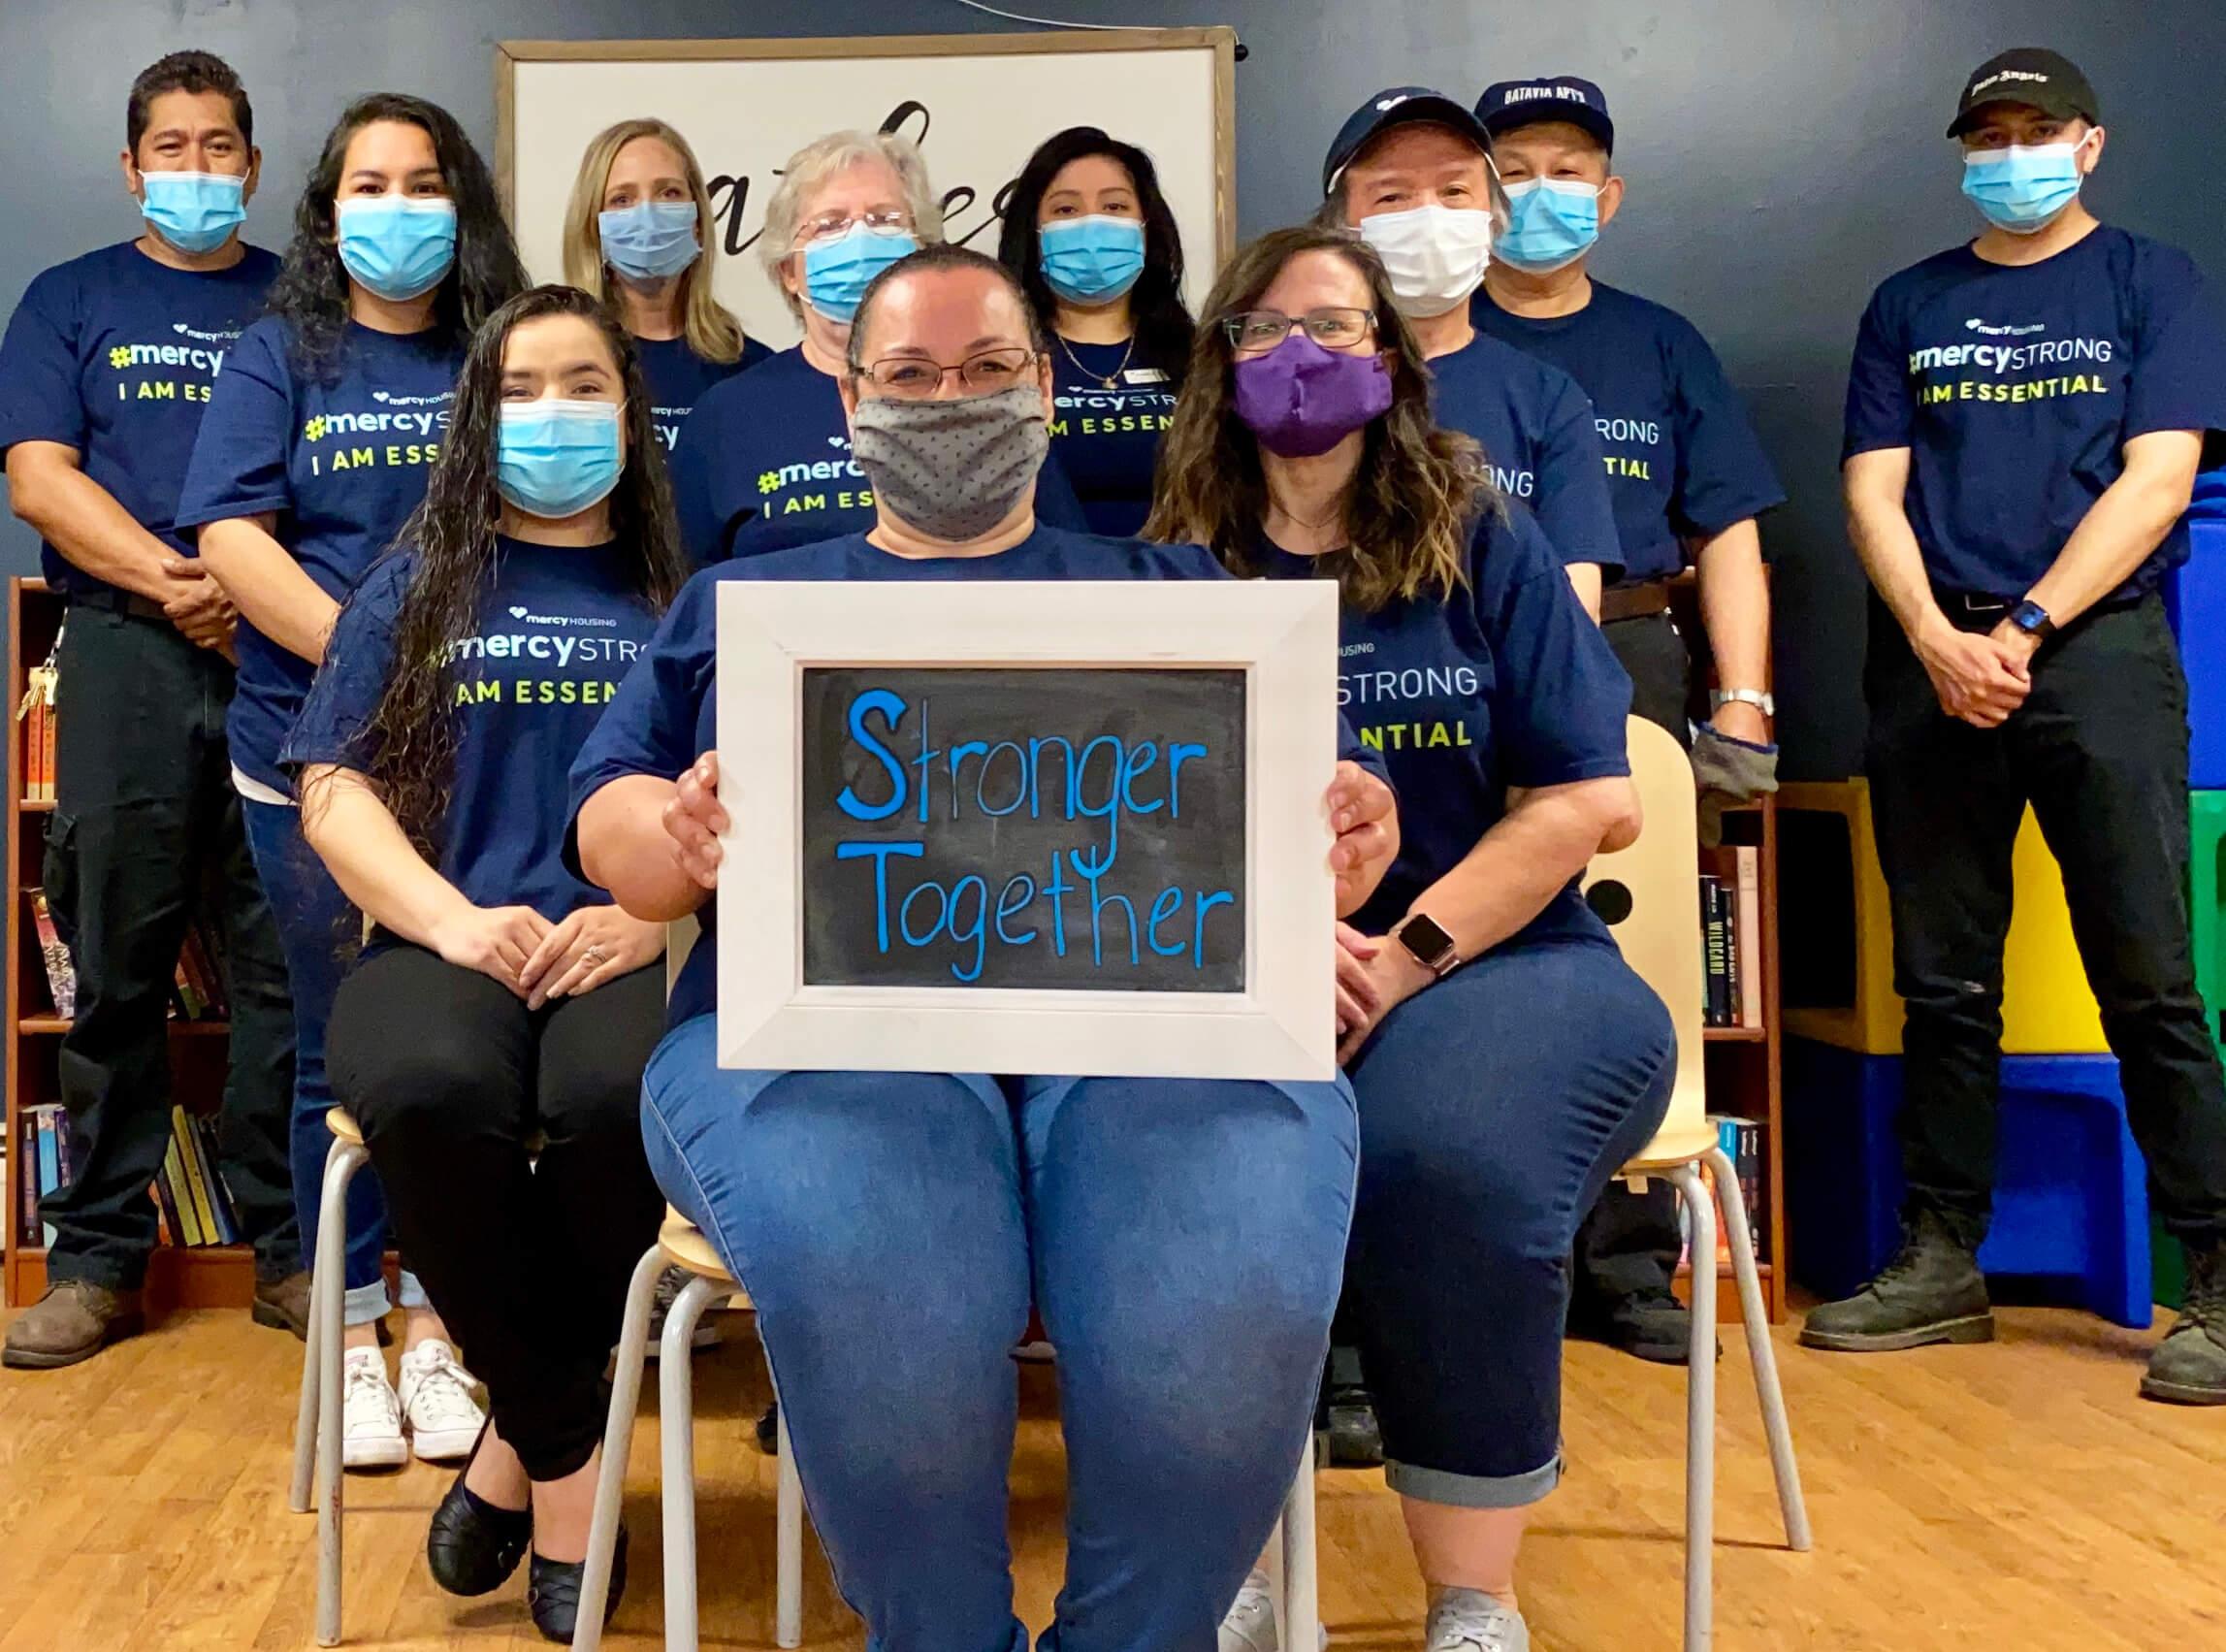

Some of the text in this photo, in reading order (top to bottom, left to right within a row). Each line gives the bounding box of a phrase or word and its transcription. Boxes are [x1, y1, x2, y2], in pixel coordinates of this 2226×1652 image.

[1504, 87, 1552, 105] BATAVIA
[109, 344, 223, 377] #mercy
[118, 381, 211, 403] I AM ES
[1922, 384, 1952, 405] AM
[1959, 374, 2110, 403] ESSENTIAL
[1081, 414, 1175, 434] ESSEN
[1595, 419, 1659, 445] RONG
[311, 443, 438, 476] I AM ESS
[1603, 457, 1650, 481] TIAL
[763, 491, 873, 519] I AM ES
[526, 615, 617, 628] mercyHOUSING
[449, 633, 647, 666] mercySTR
[1339, 642, 1375, 657] USING
[455, 680, 617, 707] AM ESSEN
[1338, 666, 1478, 706] STRONG
[1360, 720, 1472, 752] NTIAL
[836, 690, 1208, 878] Stronger
[836, 840, 1234, 982] Together
